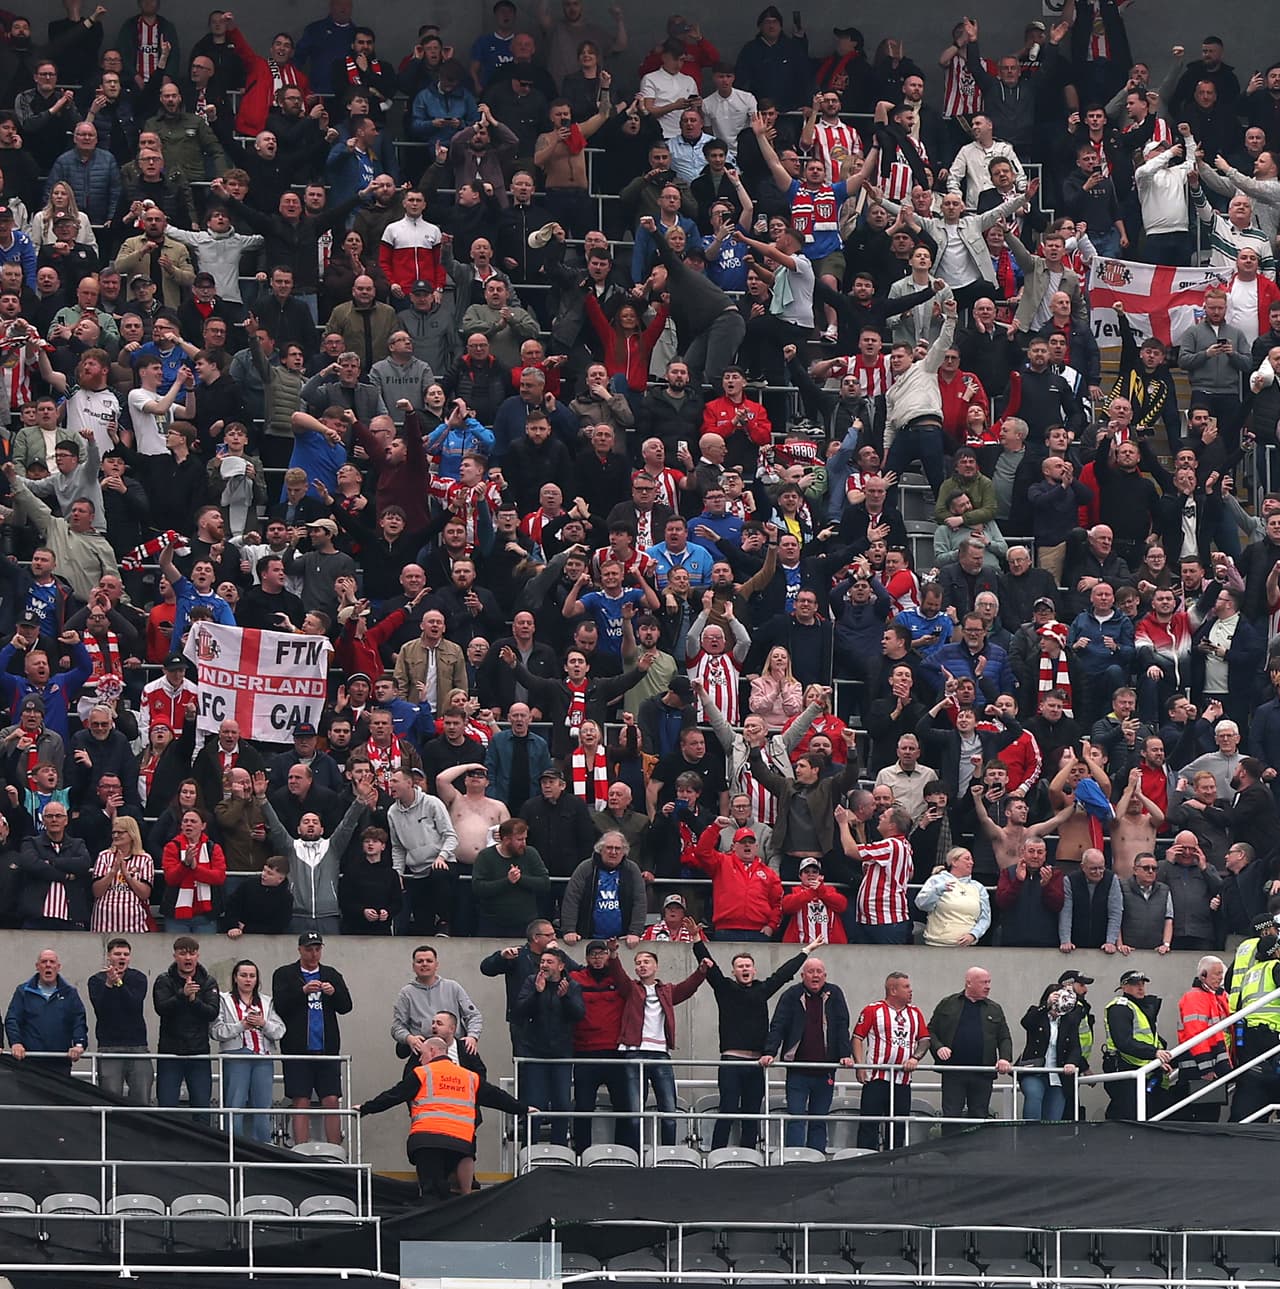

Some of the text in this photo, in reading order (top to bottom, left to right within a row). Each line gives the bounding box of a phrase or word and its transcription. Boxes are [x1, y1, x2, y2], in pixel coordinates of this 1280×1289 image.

[606, 627, 623, 637] W8
[599, 900, 619, 911] W88
[808, 913, 829, 922] W88
[440, 1075, 461, 1086] Safety
[439, 1085, 465, 1094] Steward
